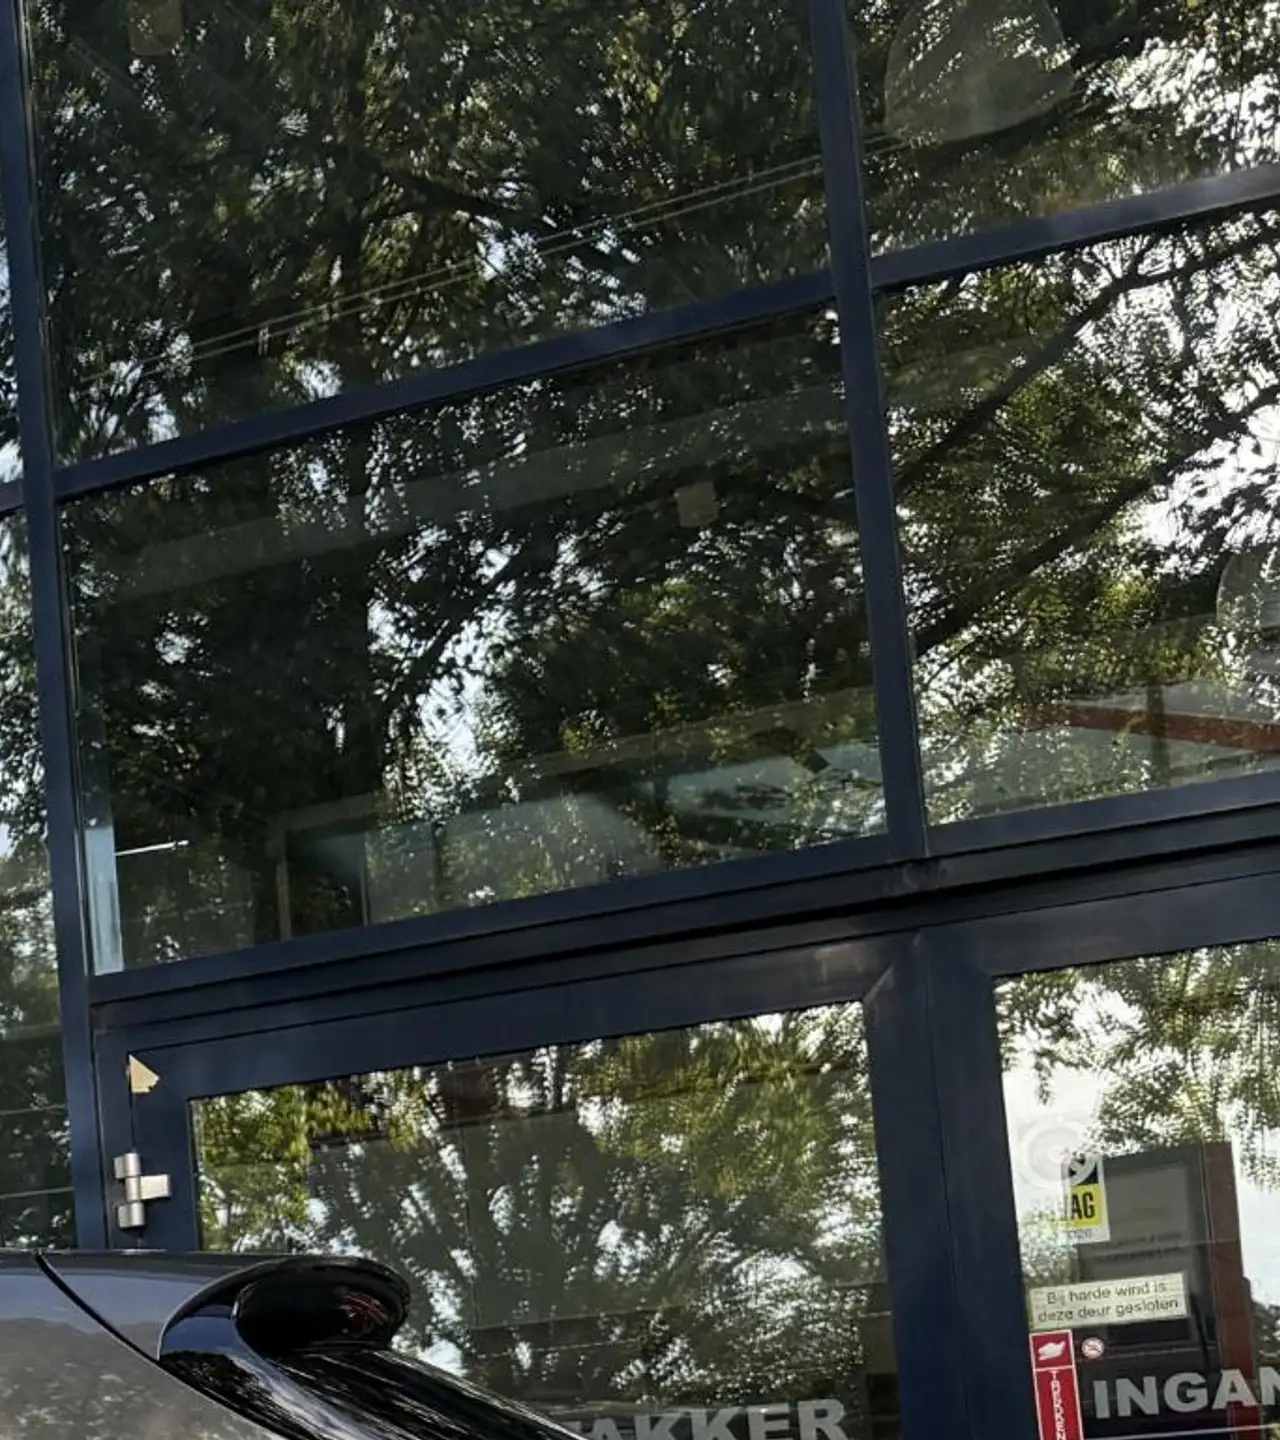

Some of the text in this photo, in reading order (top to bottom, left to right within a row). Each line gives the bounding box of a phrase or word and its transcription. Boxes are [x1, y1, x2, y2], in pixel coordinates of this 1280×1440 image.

[1047, 1280, 1167, 1306] Bij harde wind is
[1038, 1297, 1179, 1322] deze deur gesloten
